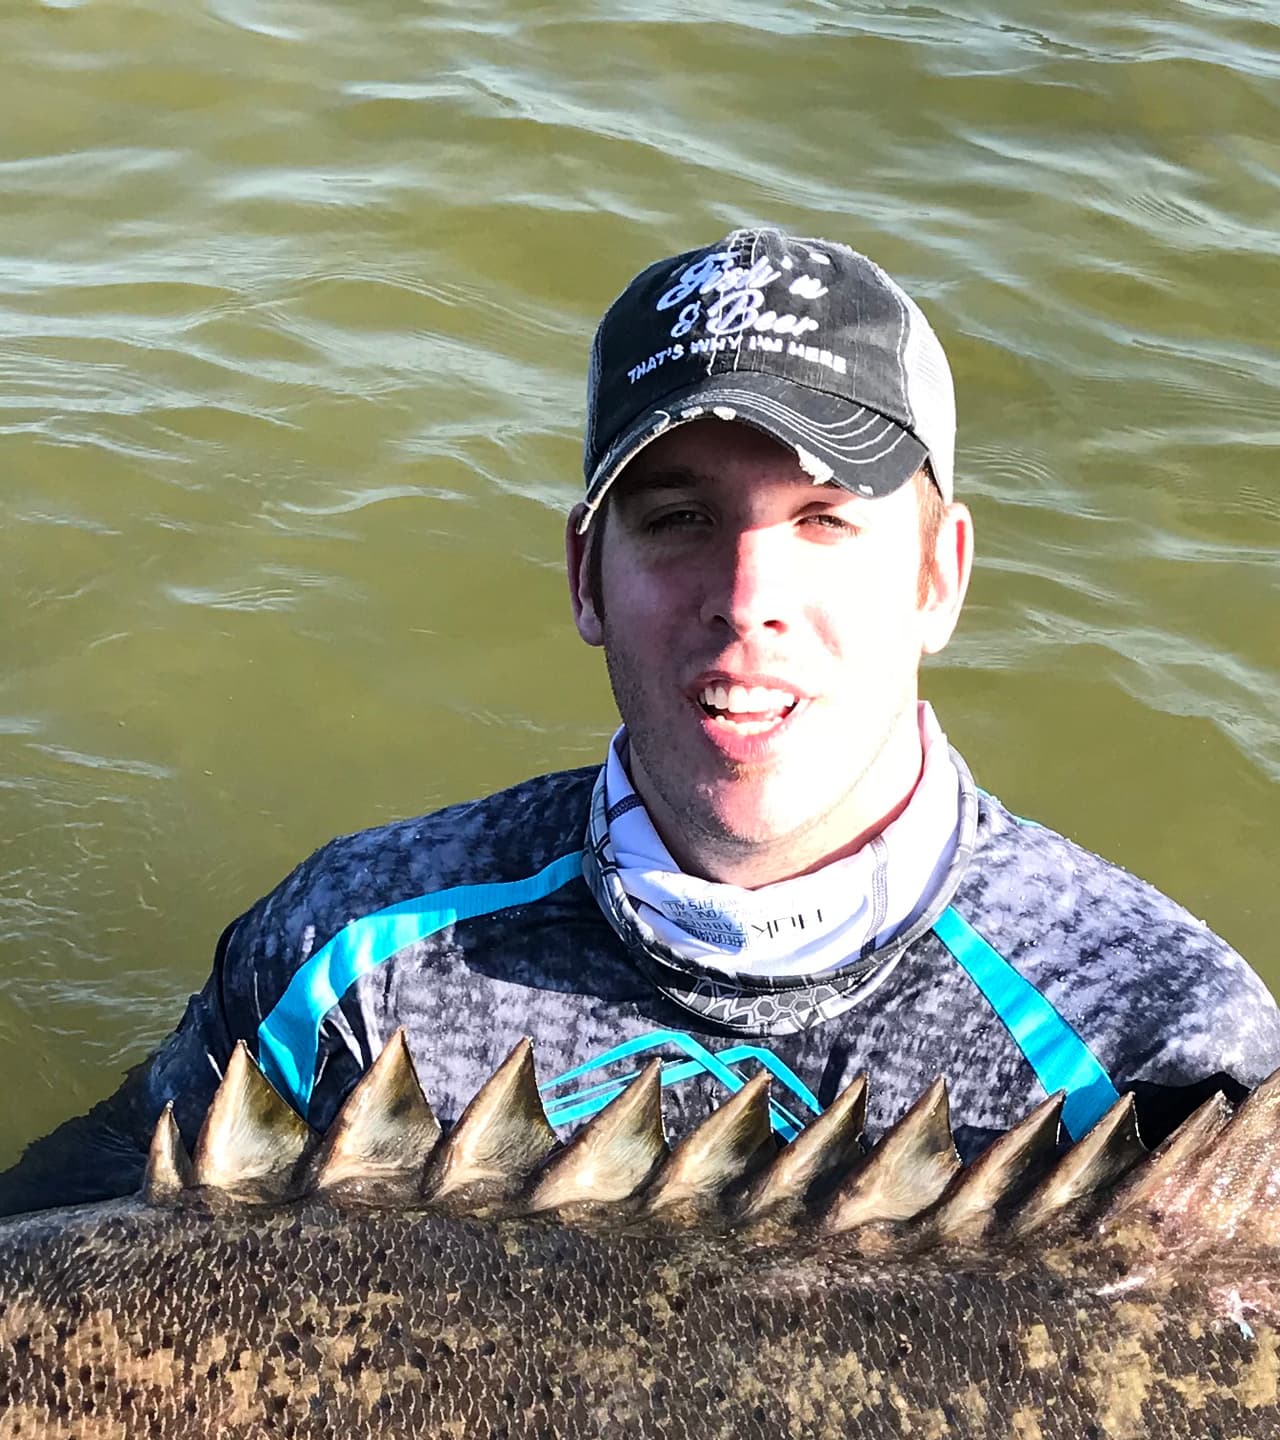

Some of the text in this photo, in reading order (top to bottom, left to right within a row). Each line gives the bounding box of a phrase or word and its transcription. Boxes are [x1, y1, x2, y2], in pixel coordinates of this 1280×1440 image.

[670, 288, 820, 338] & Beer
[627, 335, 848, 384] THAT'S WHY I'M HERE
[688, 899, 713, 911] FITS
